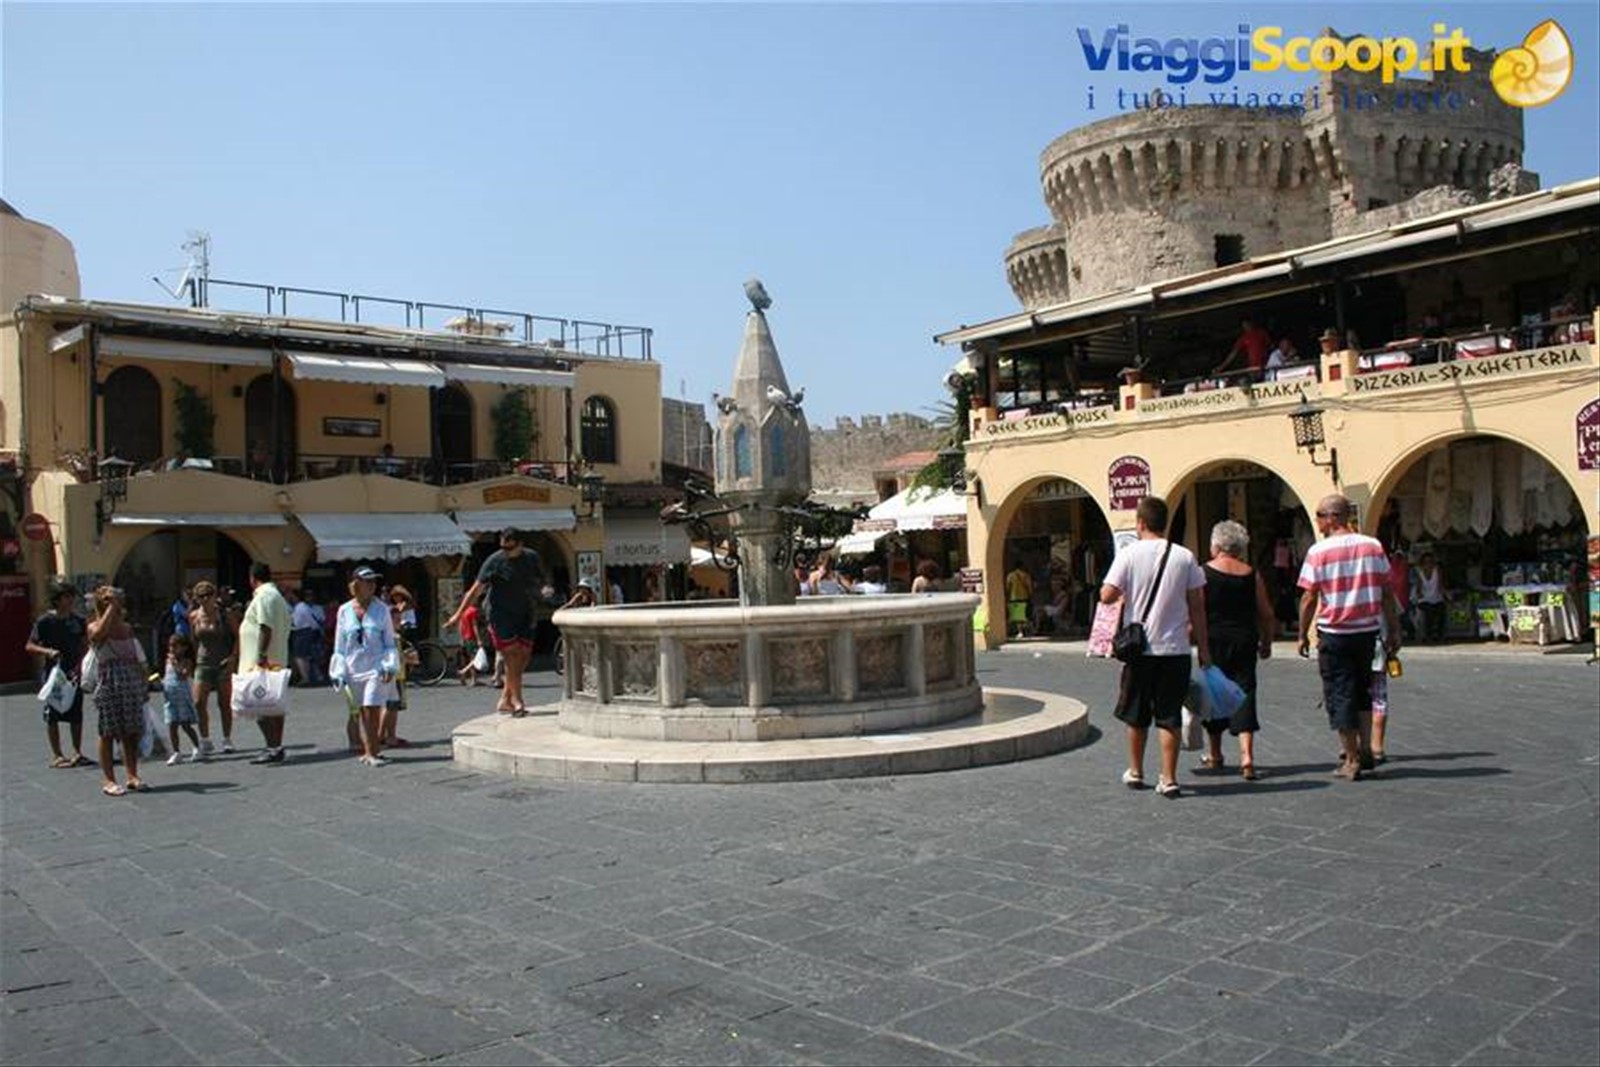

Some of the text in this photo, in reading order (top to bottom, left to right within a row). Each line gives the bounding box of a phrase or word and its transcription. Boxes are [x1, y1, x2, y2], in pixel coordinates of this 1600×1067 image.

[986, 409, 1109, 436] GREEK STEAK HOUSE
